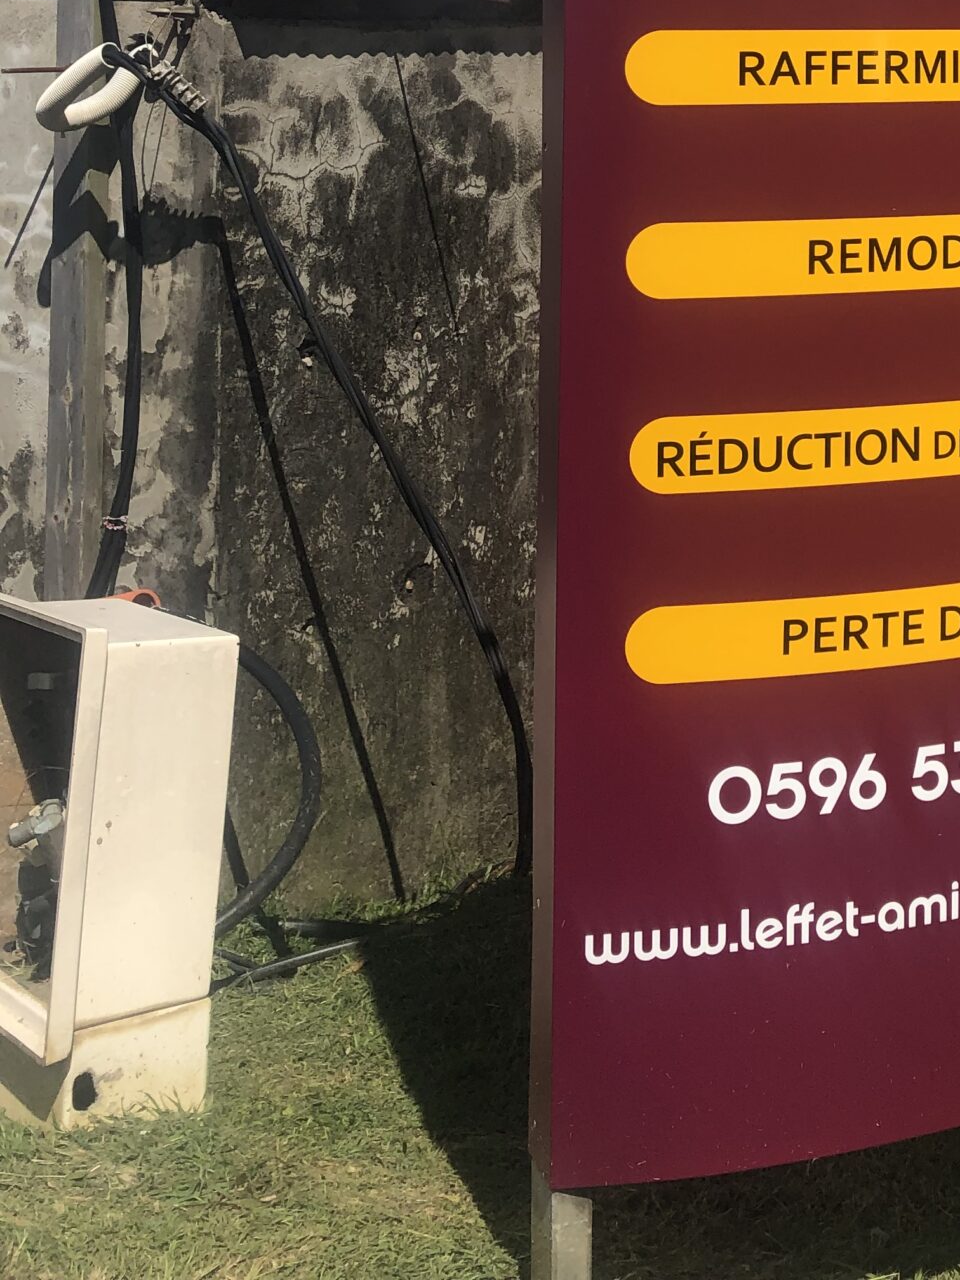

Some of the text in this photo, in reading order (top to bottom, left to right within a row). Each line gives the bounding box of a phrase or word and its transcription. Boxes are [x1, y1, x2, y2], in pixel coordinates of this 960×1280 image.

[656, 426, 921, 478] RÉDUCTION
[782, 608, 925, 656] PERTE
[707, 753, 887, 825] 0596
